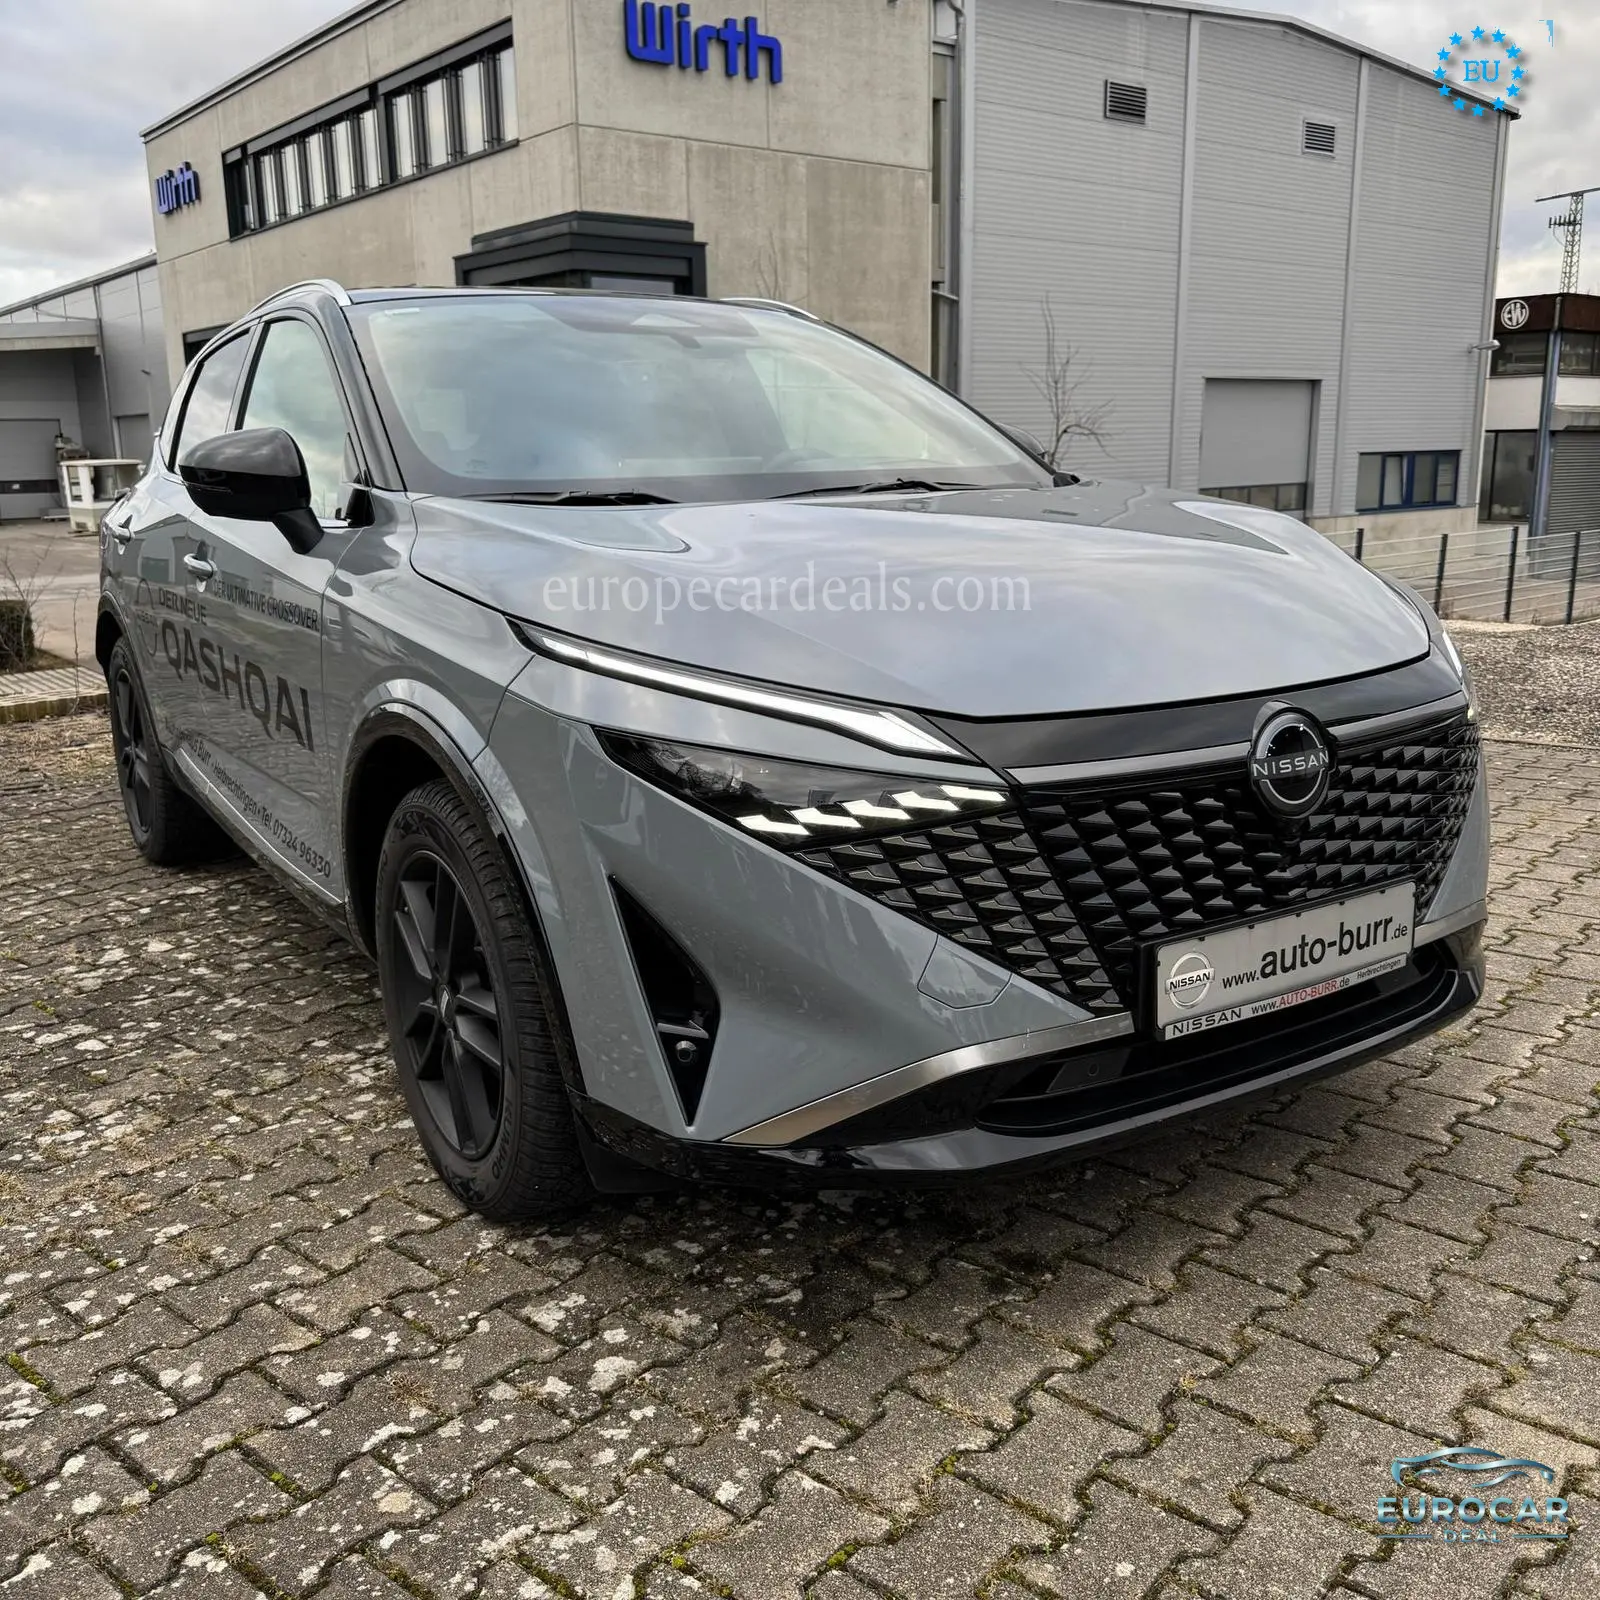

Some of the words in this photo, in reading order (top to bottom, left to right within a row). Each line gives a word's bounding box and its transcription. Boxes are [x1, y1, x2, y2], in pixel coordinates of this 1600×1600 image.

[624, 0, 783, 84] Wirth
[154, 161, 201, 214] Wirth
[159, 587, 179, 612] DER
[180, 598, 207, 626] NEUE
[162, 619, 314, 752] QASHQAI
[1253, 750, 1329, 777] NISSAN
[262, 807, 272, 830] Tel.
[273, 819, 298, 852] 07324
[300, 841, 331, 877] 96330
[1169, 971, 1211, 991] NISSAN
[1222, 916, 1408, 990] www.auto-burr.de
[1172, 1008, 1242, 1037] NISSAN
[1251, 977, 1350, 1015] www.AUTO-BURR.de
